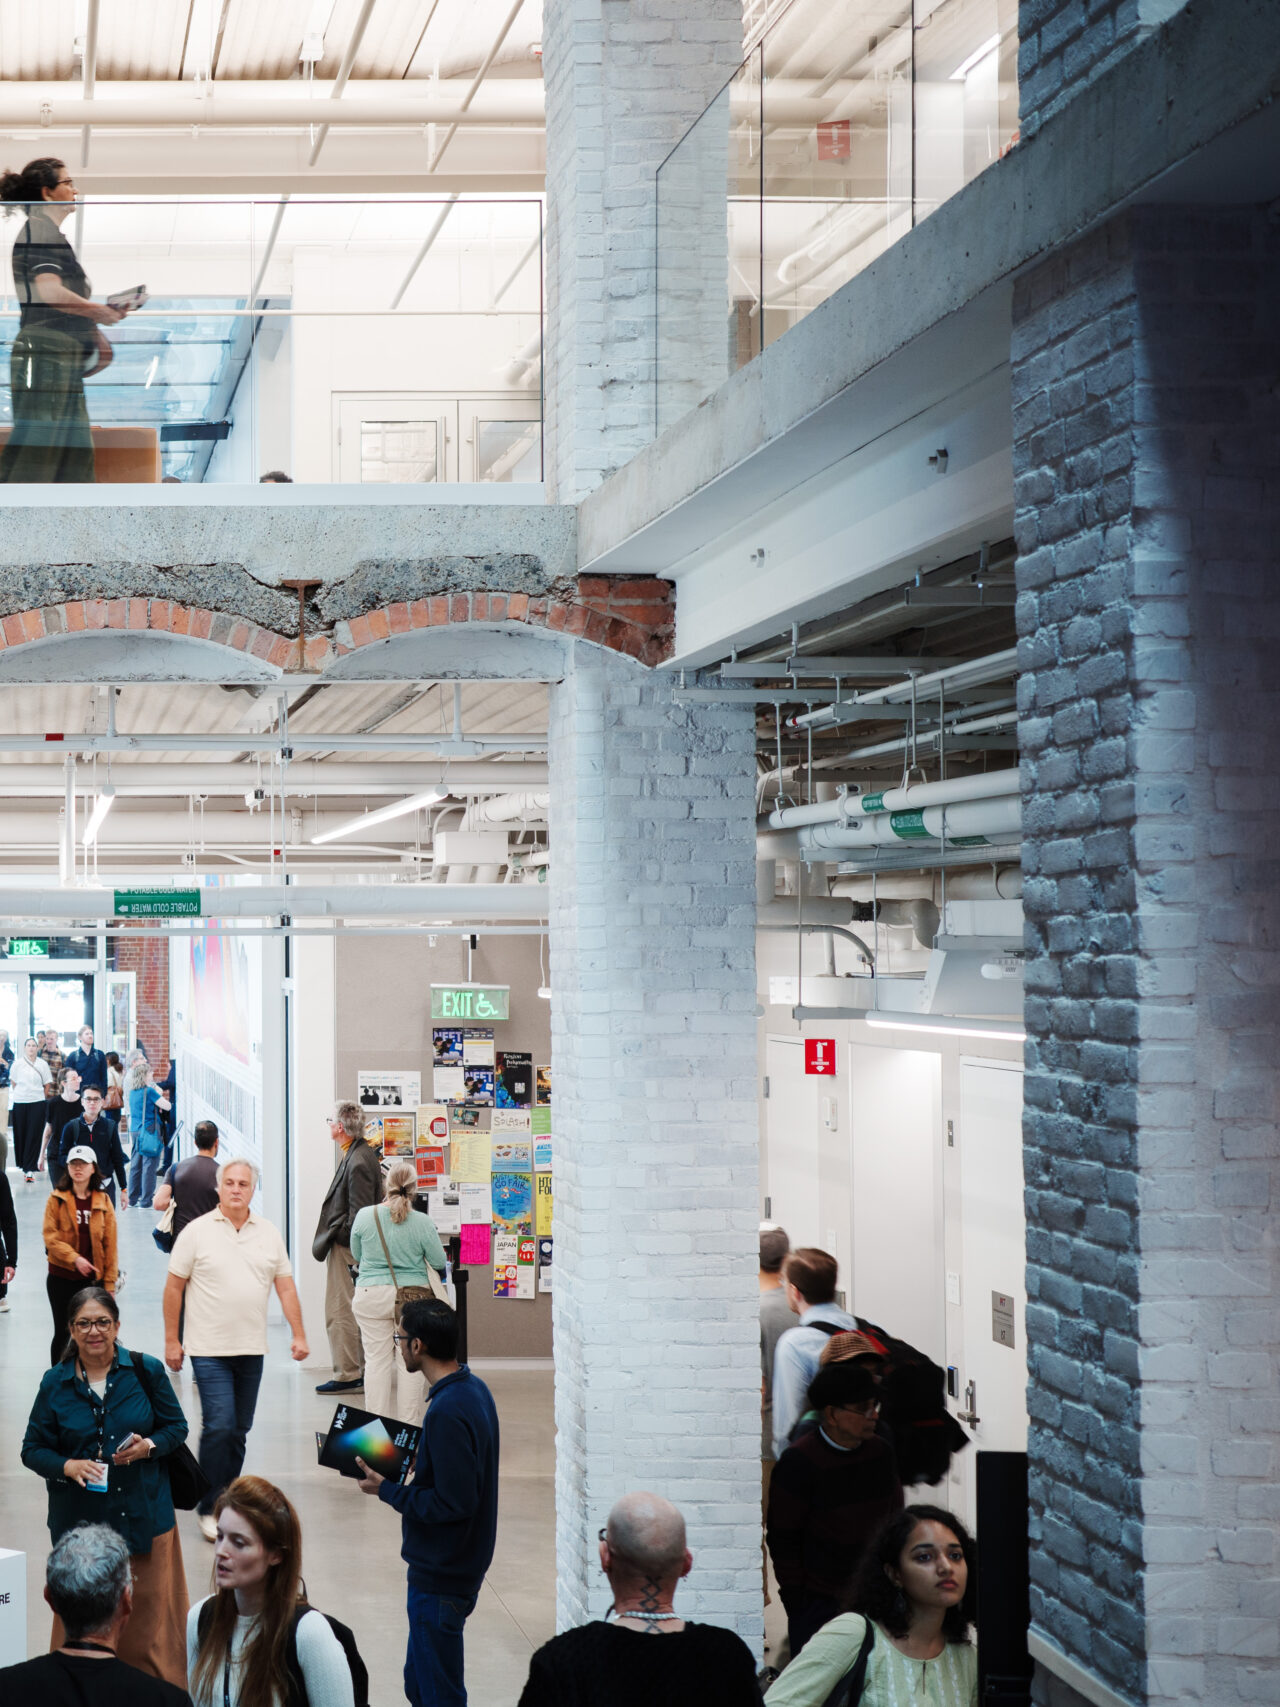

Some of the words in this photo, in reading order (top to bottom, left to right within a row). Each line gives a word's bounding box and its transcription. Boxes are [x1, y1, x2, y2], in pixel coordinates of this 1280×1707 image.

[131, 903, 152, 913] WATER
[153, 903, 169, 913] COLD
[171, 902, 198, 912] POTABLE
[13, 941, 30, 955] EXIT
[442, 991, 473, 1017] EXIT
[495, 1181, 507, 1189] GO
[508, 1179, 528, 1191] FAIR
